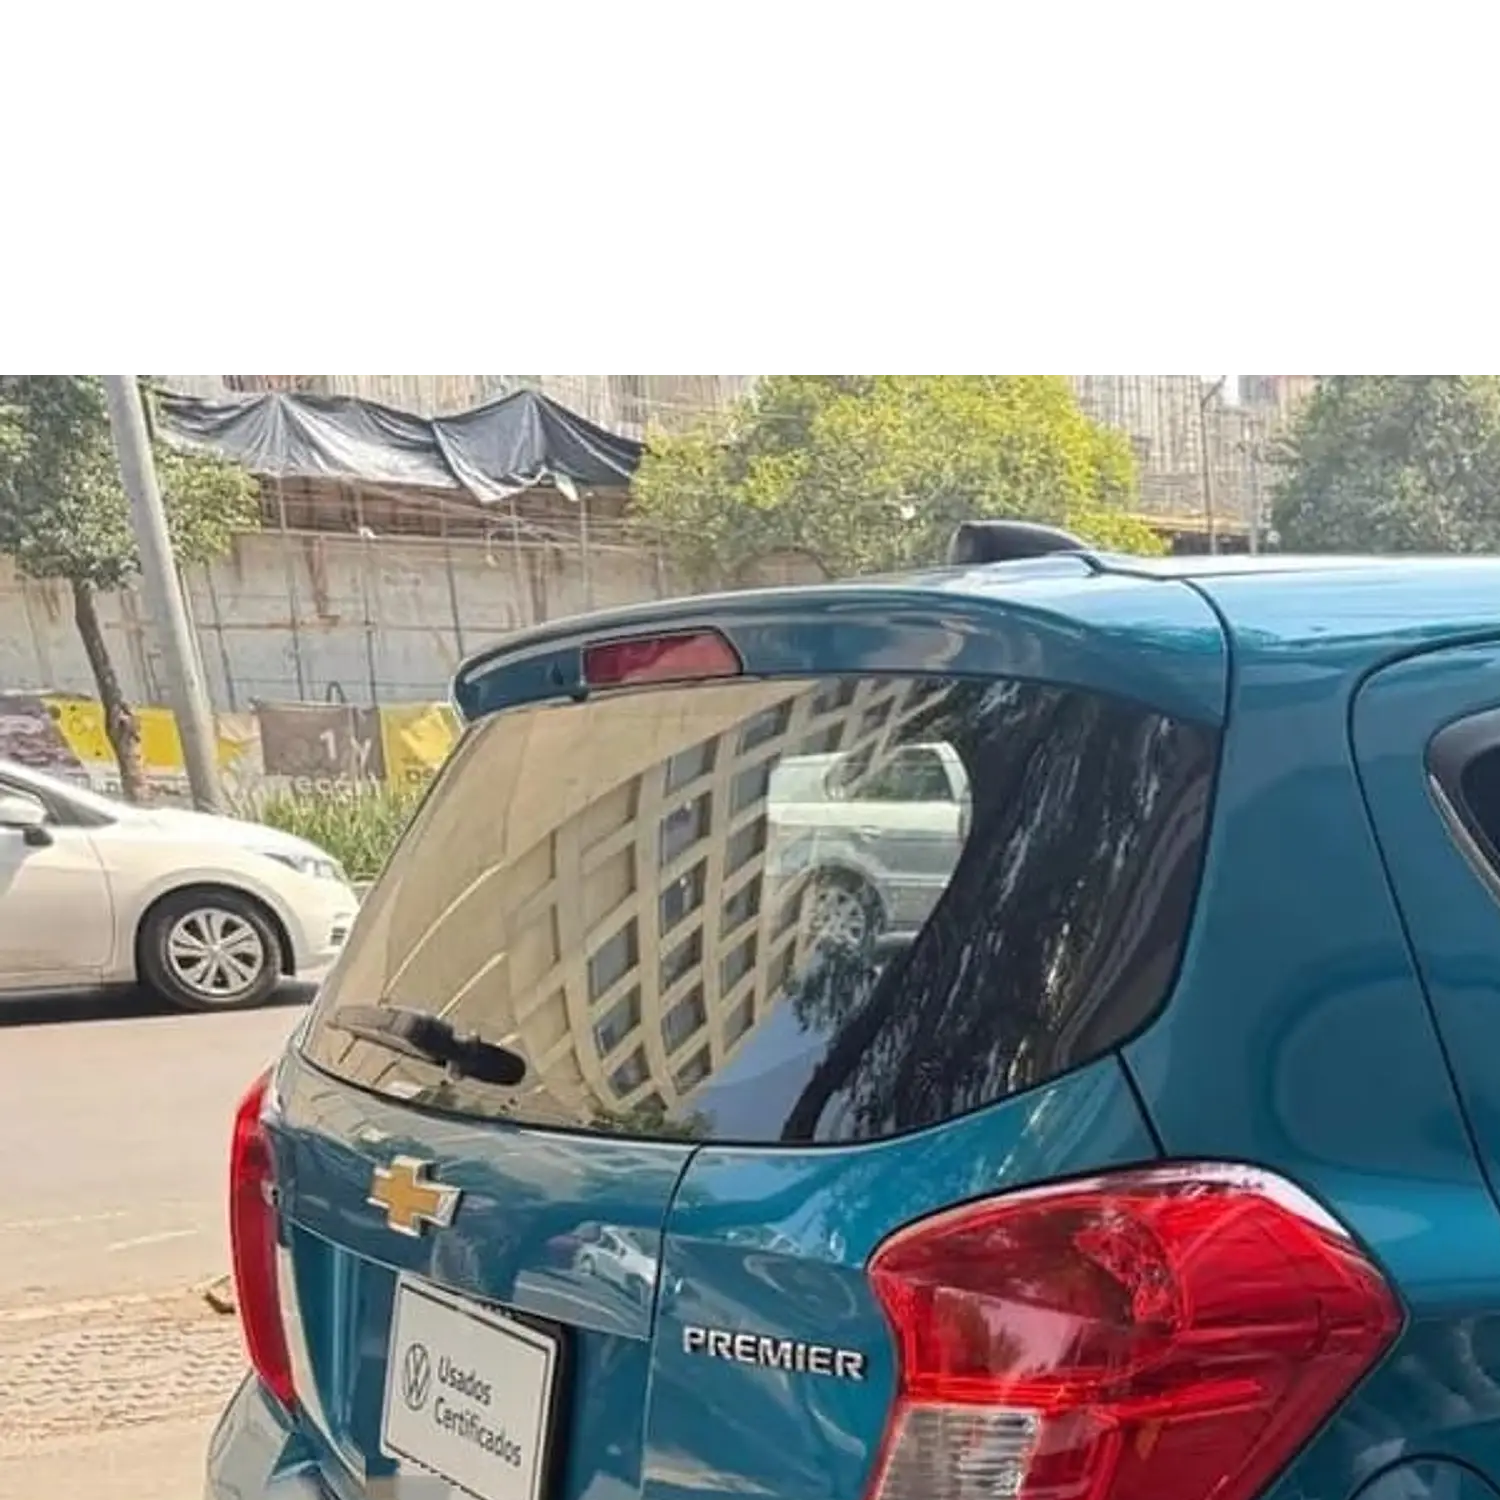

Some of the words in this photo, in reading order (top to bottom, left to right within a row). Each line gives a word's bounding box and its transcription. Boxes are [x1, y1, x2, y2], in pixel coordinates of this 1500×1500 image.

[438, 1355, 492, 1406] Usados
[682, 1325, 867, 1381] PREMIER
[434, 1395, 522, 1467] Certificados
